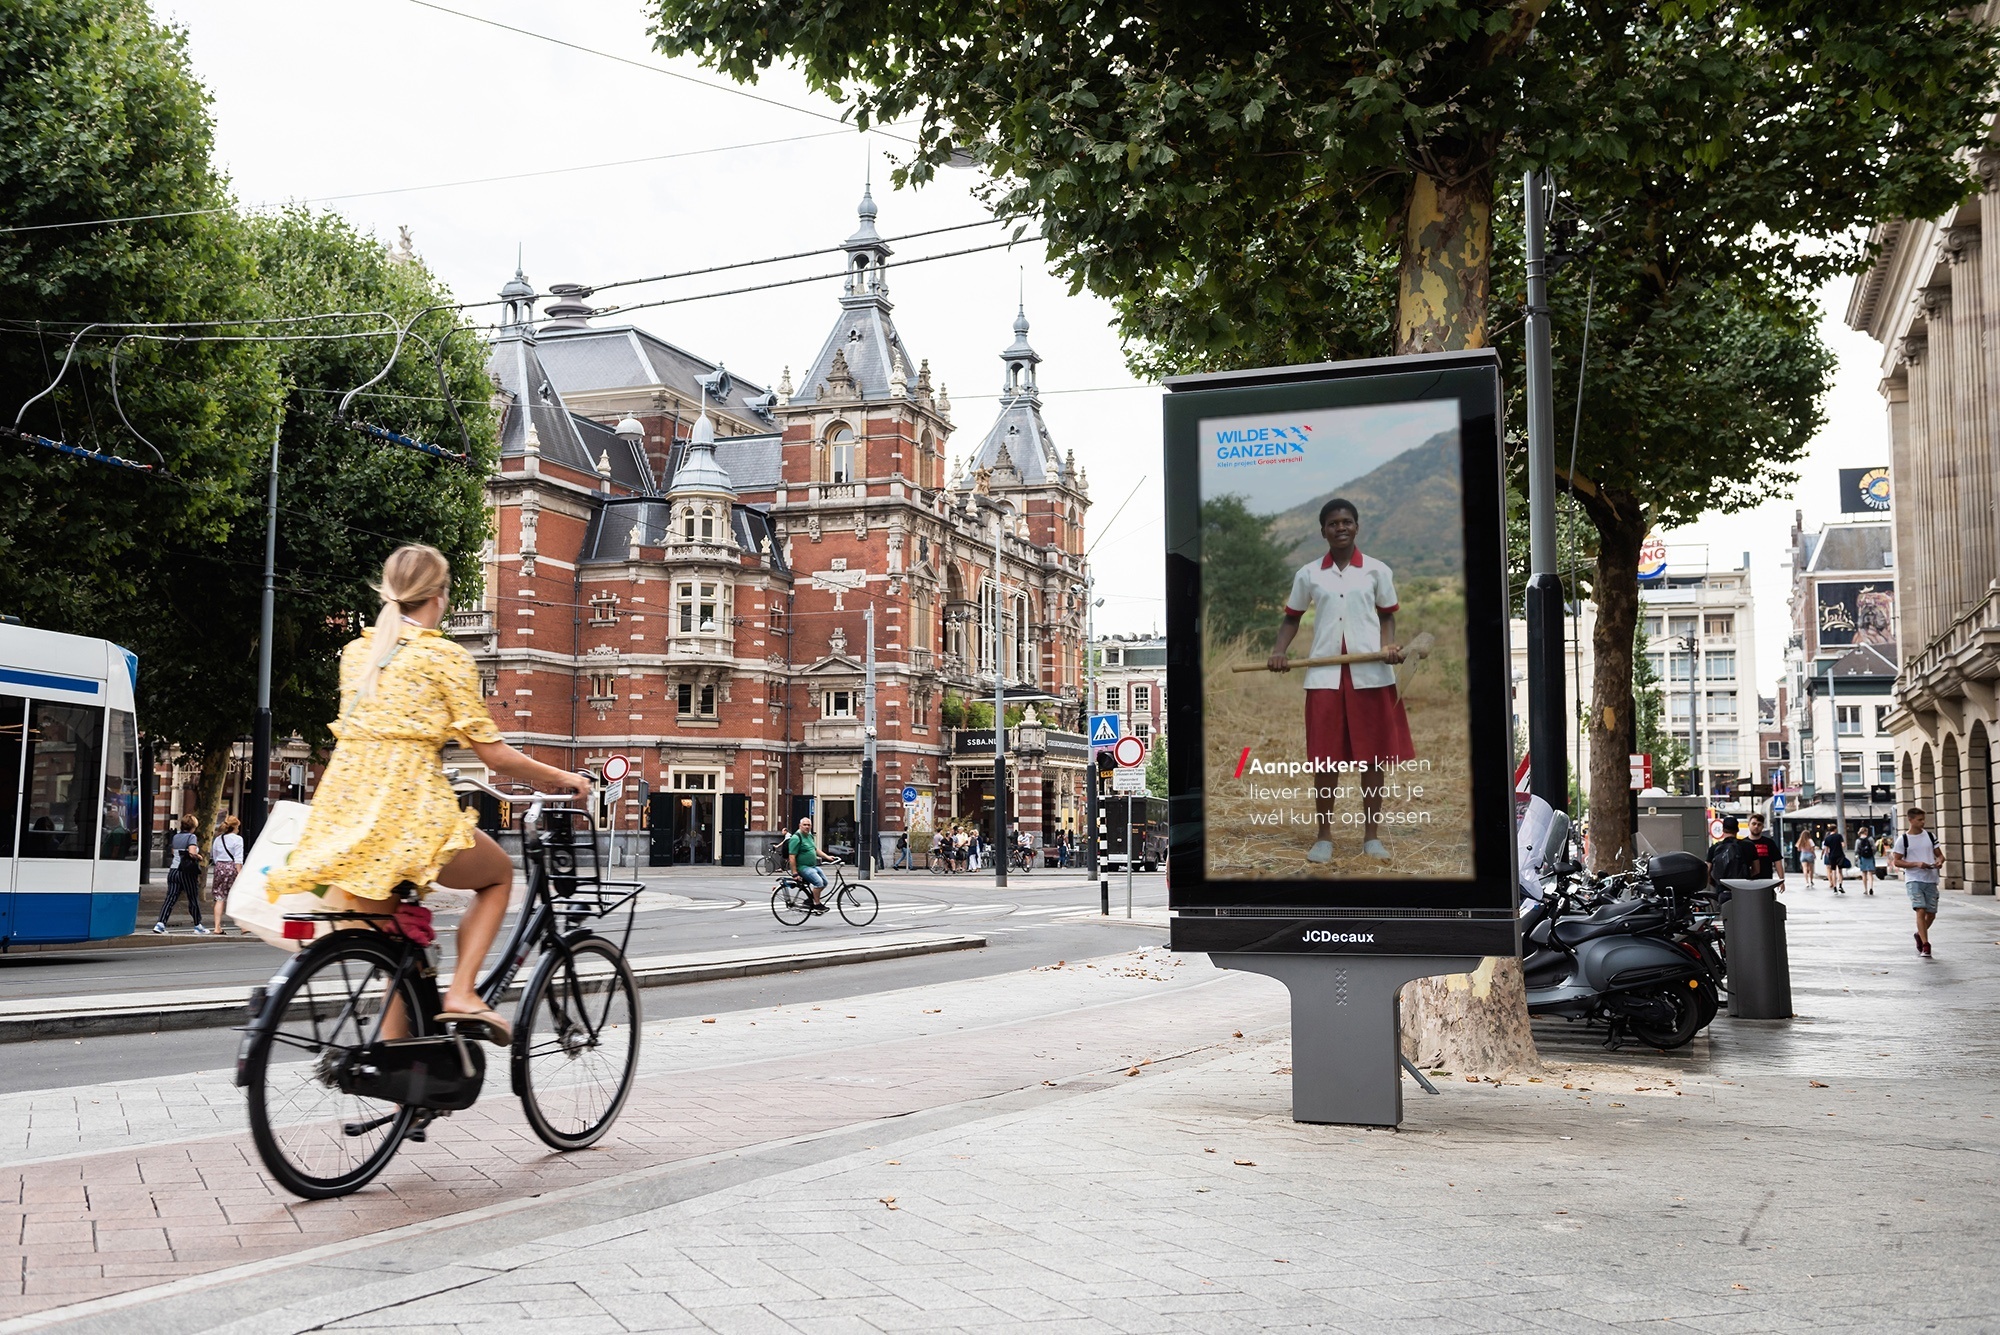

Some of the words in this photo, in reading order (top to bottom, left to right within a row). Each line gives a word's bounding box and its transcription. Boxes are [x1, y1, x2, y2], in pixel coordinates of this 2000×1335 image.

[1216, 428, 1268, 444] WILDE
[1217, 442, 1287, 459] GANZEN
[1233, 459, 1257, 468] project
[1249, 756, 1369, 778] Aanpakkers
[1374, 755, 1431, 776] kijken
[1249, 784, 1300, 800] liever
[1307, 785, 1354, 799] naar
[1359, 784, 1401, 798] wat
[1405, 781, 1424, 802] je
[1710, 800, 1726, 810] NG
[1249, 809, 1283, 825] wél
[1290, 807, 1335, 825] kunt
[1341, 806, 1431, 828] oplossen
[1302, 930, 1375, 943] JCDecaux
